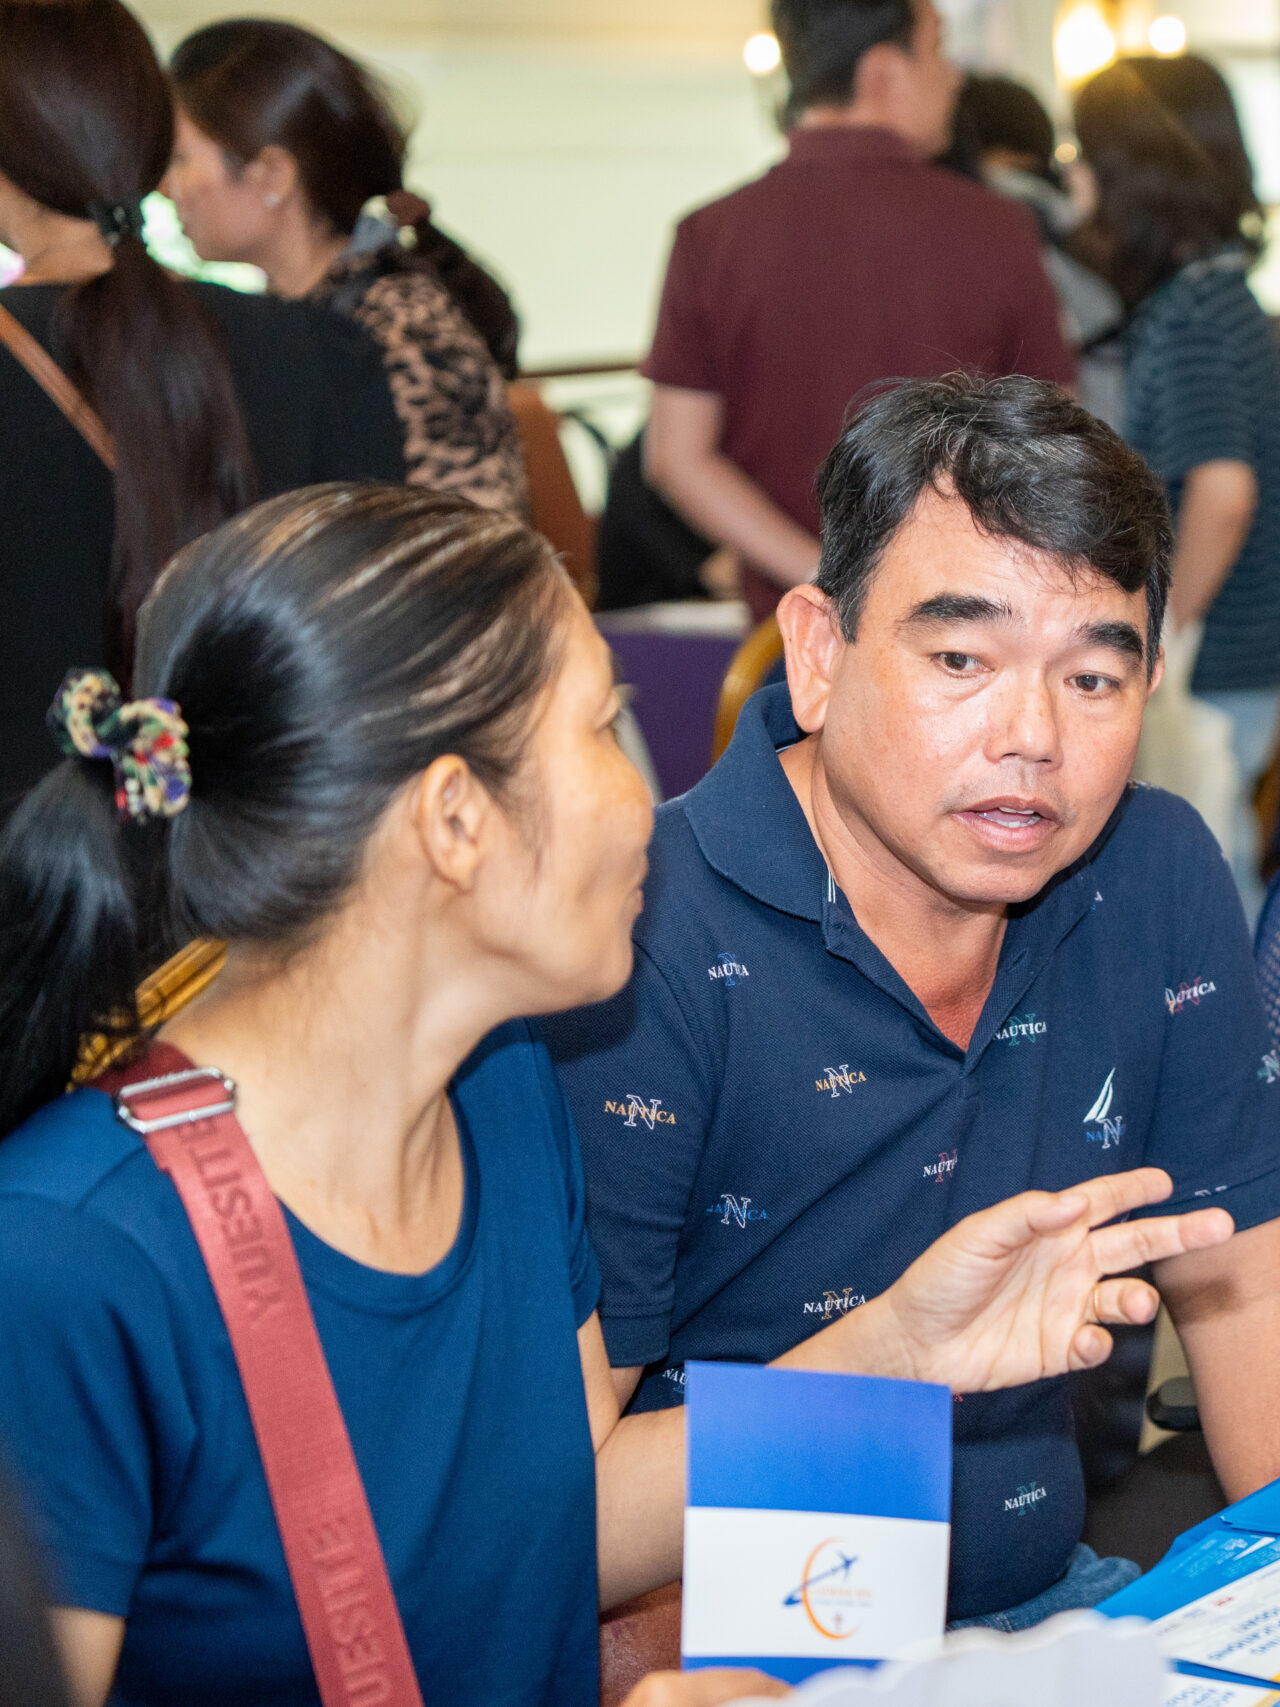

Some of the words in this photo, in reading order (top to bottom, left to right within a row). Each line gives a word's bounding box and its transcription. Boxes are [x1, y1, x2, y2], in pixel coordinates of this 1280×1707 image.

[604, 1100, 677, 1125] NAUTICA
[803, 1294, 866, 1314] NAUTICA
[1004, 1487, 1047, 1511] NAUTICA
